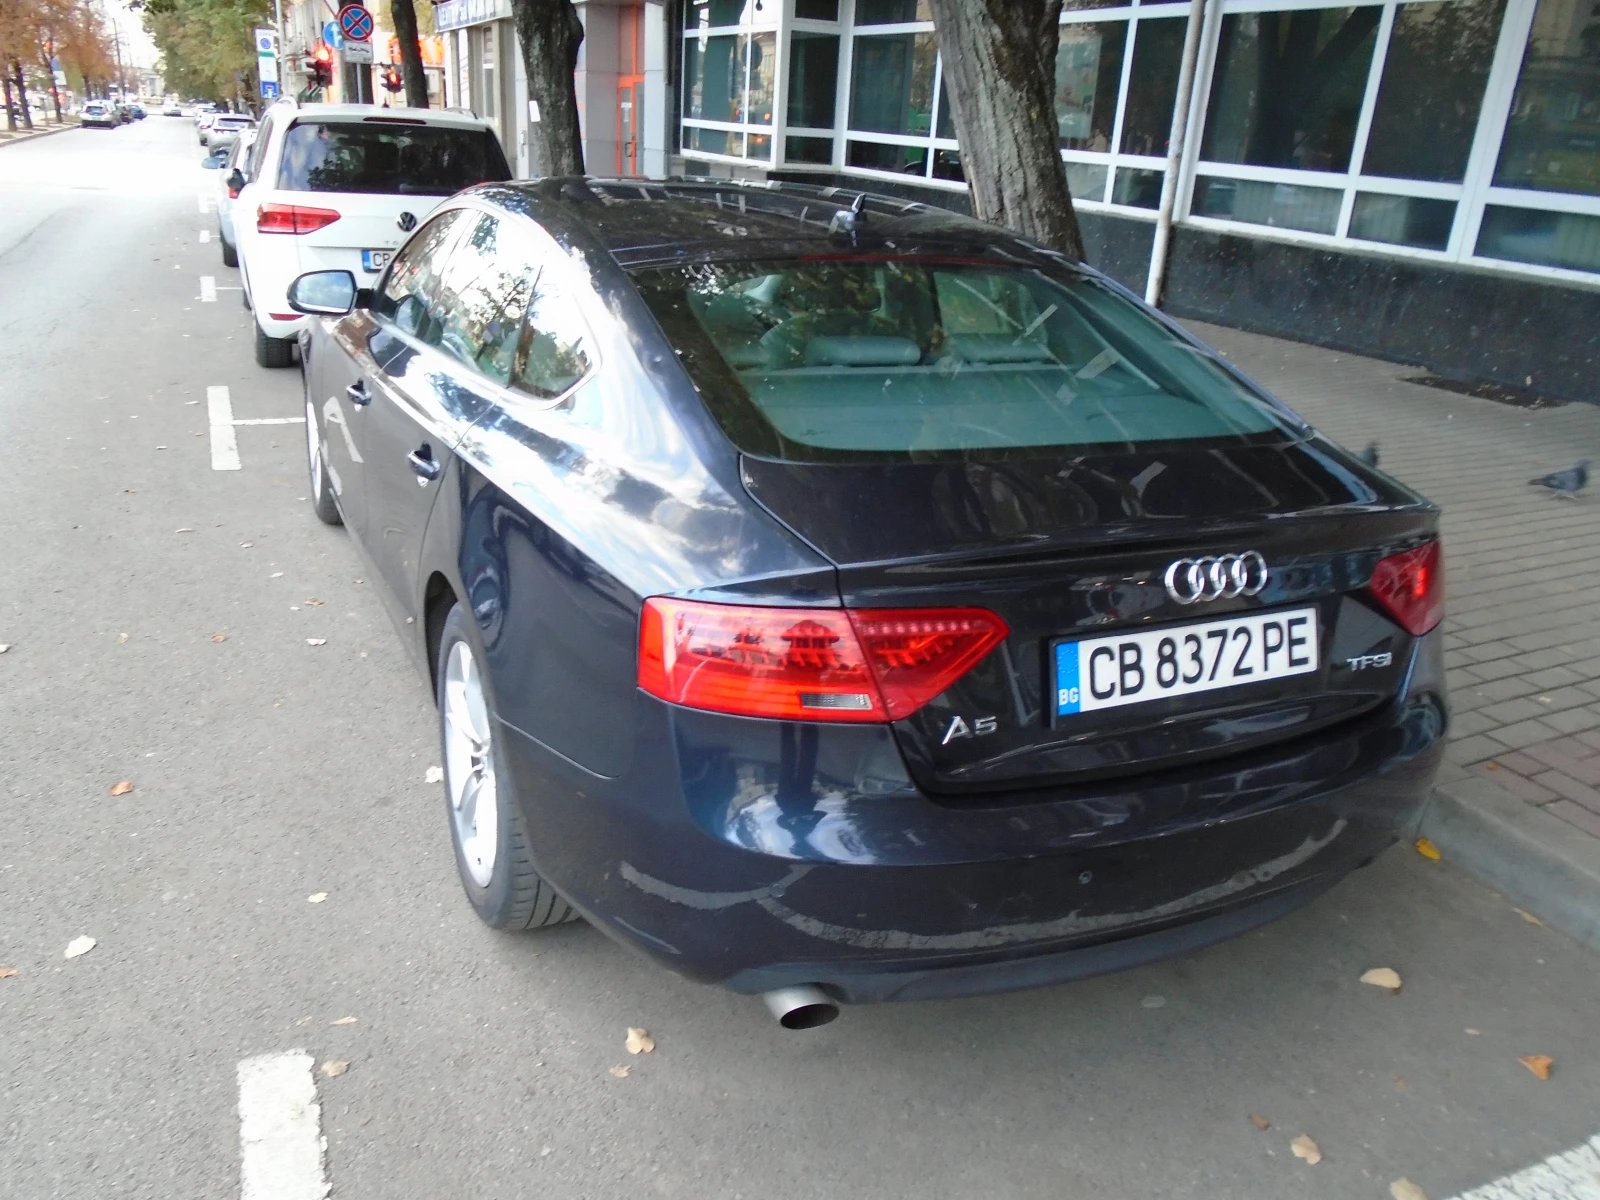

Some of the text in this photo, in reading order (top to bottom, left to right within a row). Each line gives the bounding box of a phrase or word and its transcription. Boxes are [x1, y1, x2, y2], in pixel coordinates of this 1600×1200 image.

[1089, 616, 1310, 700] CB 8372 PE
[1346, 651, 1393, 672] TFSI
[1058, 687, 1080, 706] BG
[942, 715, 998, 745] A5
